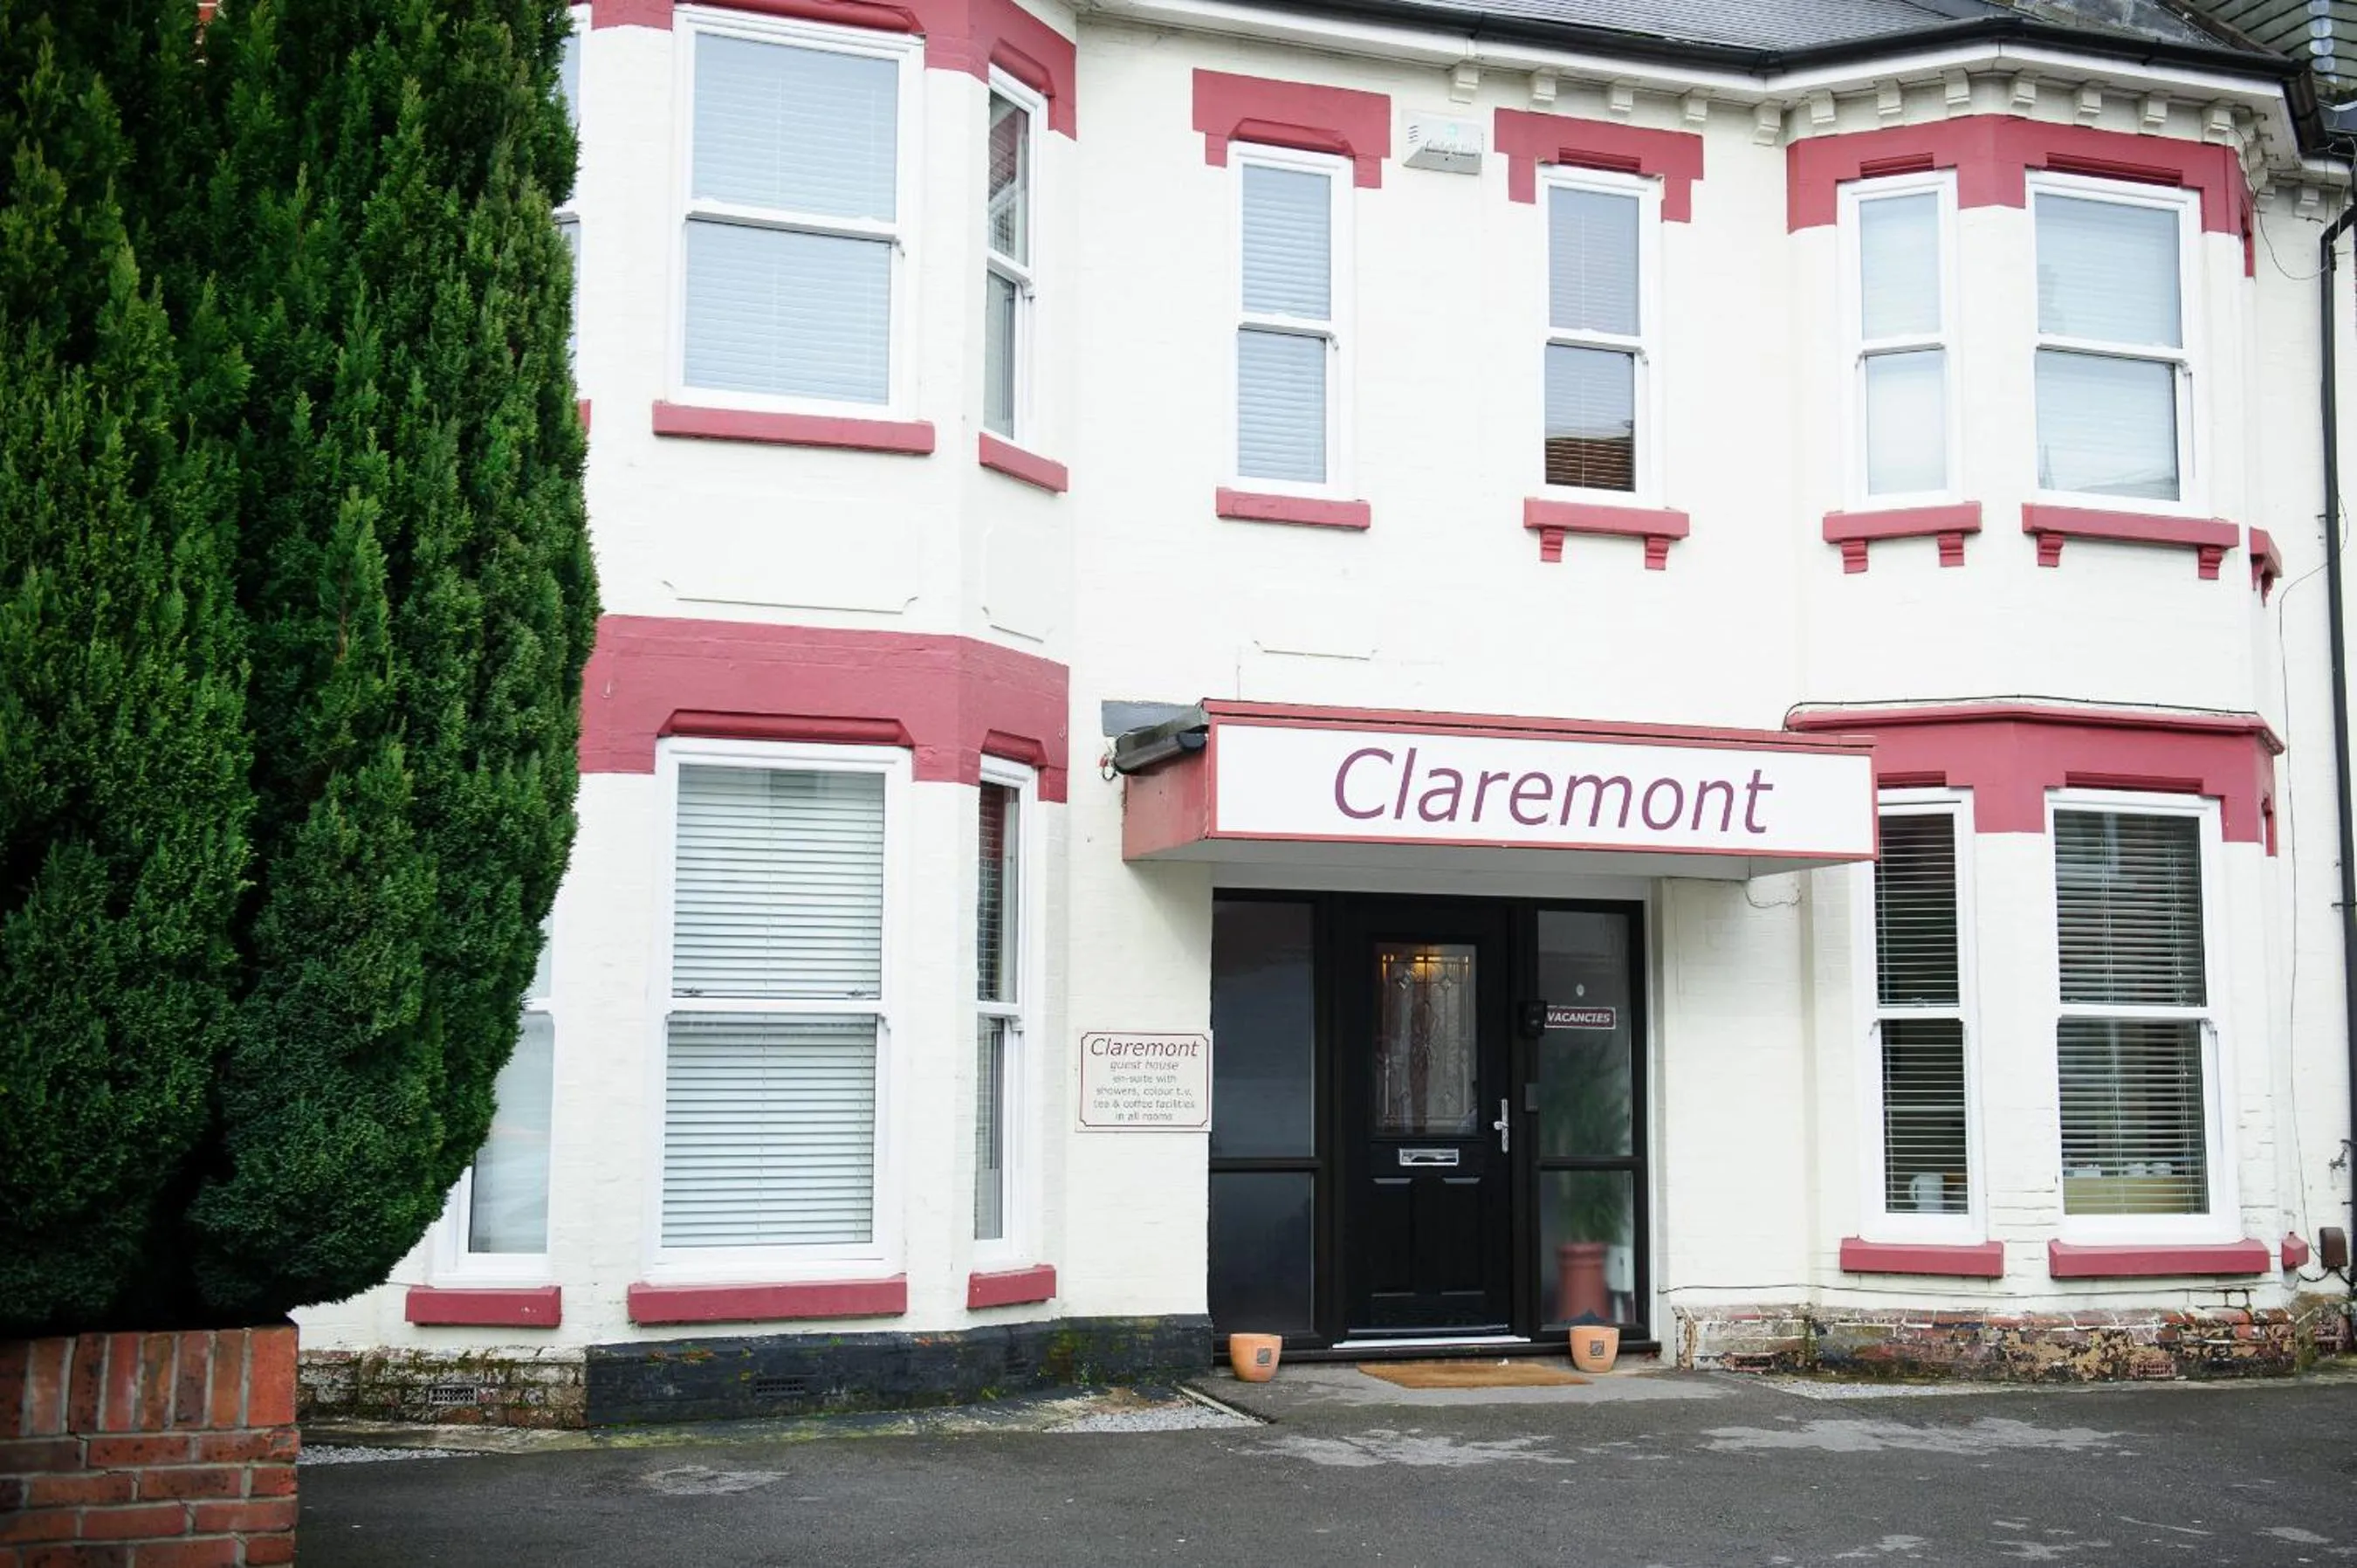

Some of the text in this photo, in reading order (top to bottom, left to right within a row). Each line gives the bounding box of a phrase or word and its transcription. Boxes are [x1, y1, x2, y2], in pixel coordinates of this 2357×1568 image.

[1334, 746, 1773, 834] Claremont
[1547, 1012, 1610, 1022] VACANCIES
[1091, 1037, 1199, 1056] Claremont
[1110, 1060, 1178, 1072] guest house
[1112, 1074, 1176, 1083] en-suite with
[1096, 1086, 1139, 1097] showers,
[1144, 1086, 1173, 1096] colour
[1093, 1099, 1110, 1108] tea
[1123, 1099, 1152, 1108] coffee
[1155, 1098, 1194, 1108] facilities
[1116, 1111, 1124, 1120] in
[1127, 1111, 1139, 1120] all
